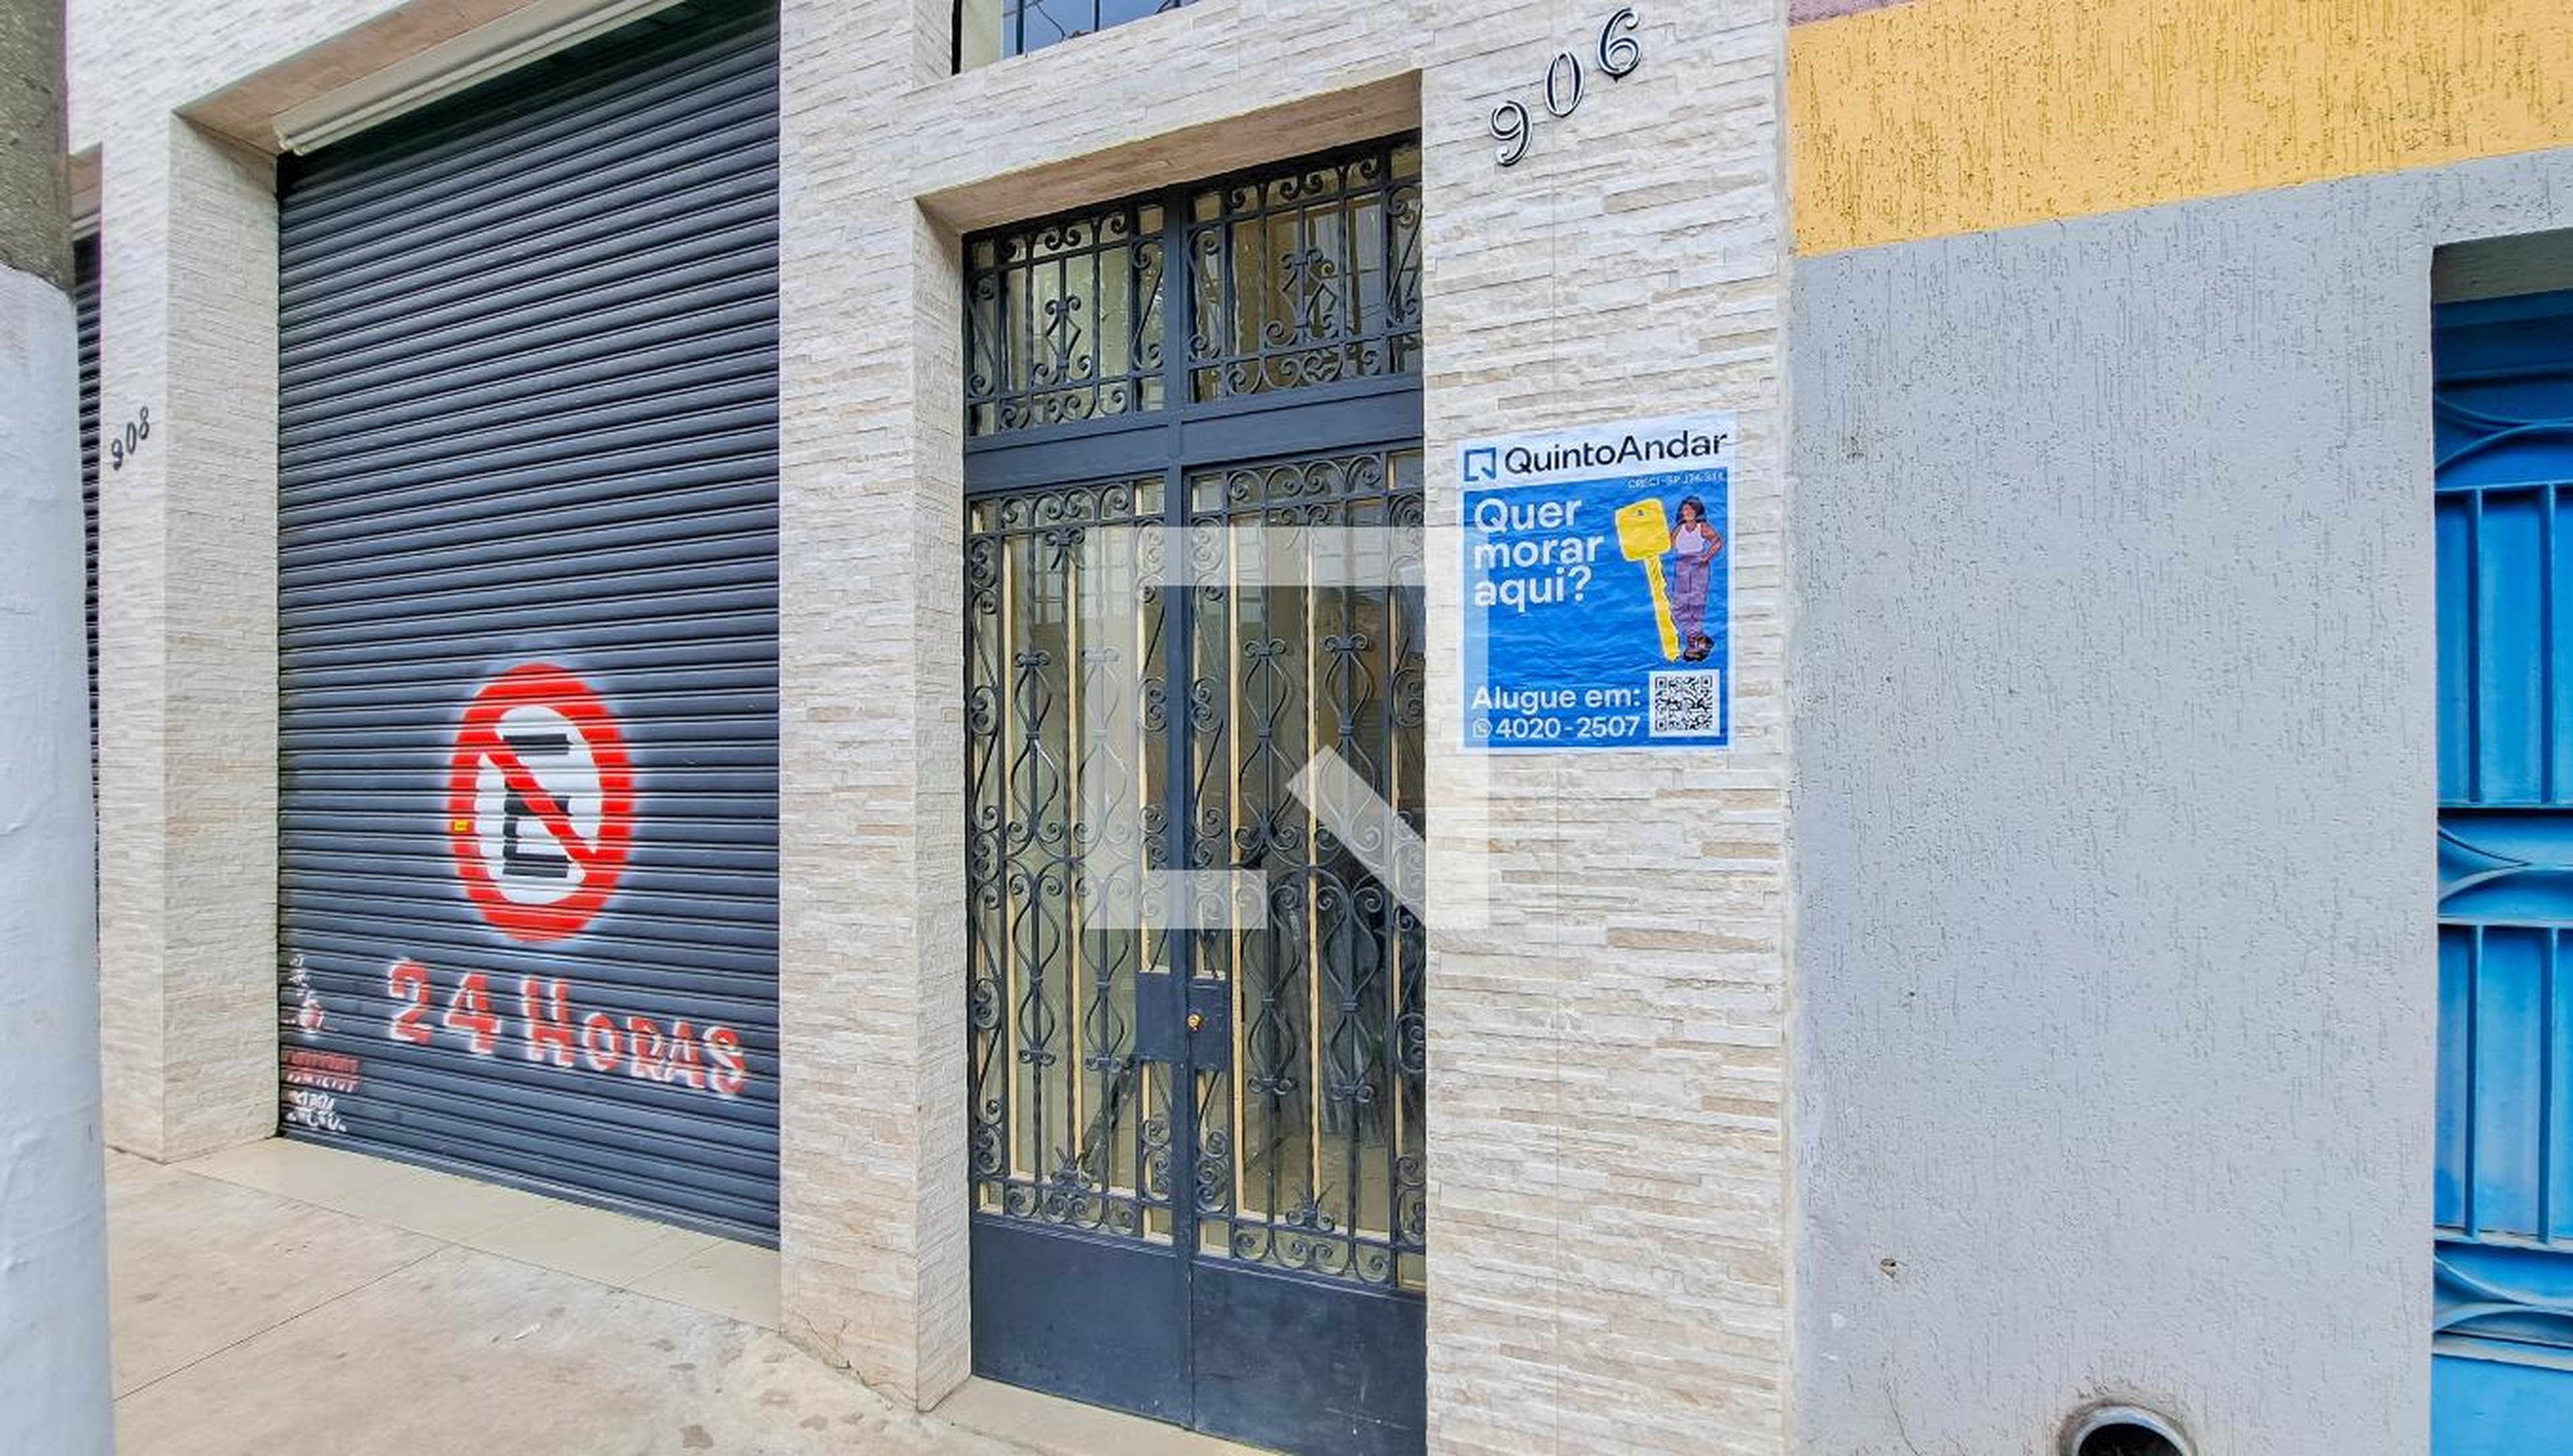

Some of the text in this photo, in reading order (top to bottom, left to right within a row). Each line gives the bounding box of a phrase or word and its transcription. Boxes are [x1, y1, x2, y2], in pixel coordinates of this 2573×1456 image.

[1490, 7, 1642, 167] 906
[111, 405, 149, 470] 908
[1505, 430, 1727, 474] QuintoAndar
[1475, 498, 1582, 533] Quer
[1475, 536, 1605, 569] morar
[1475, 565, 1592, 613] aqui?
[1471, 685, 1641, 715] Alugue em:
[1496, 716, 1641, 738] 4020-2507
[387, 958, 502, 1055] 24
